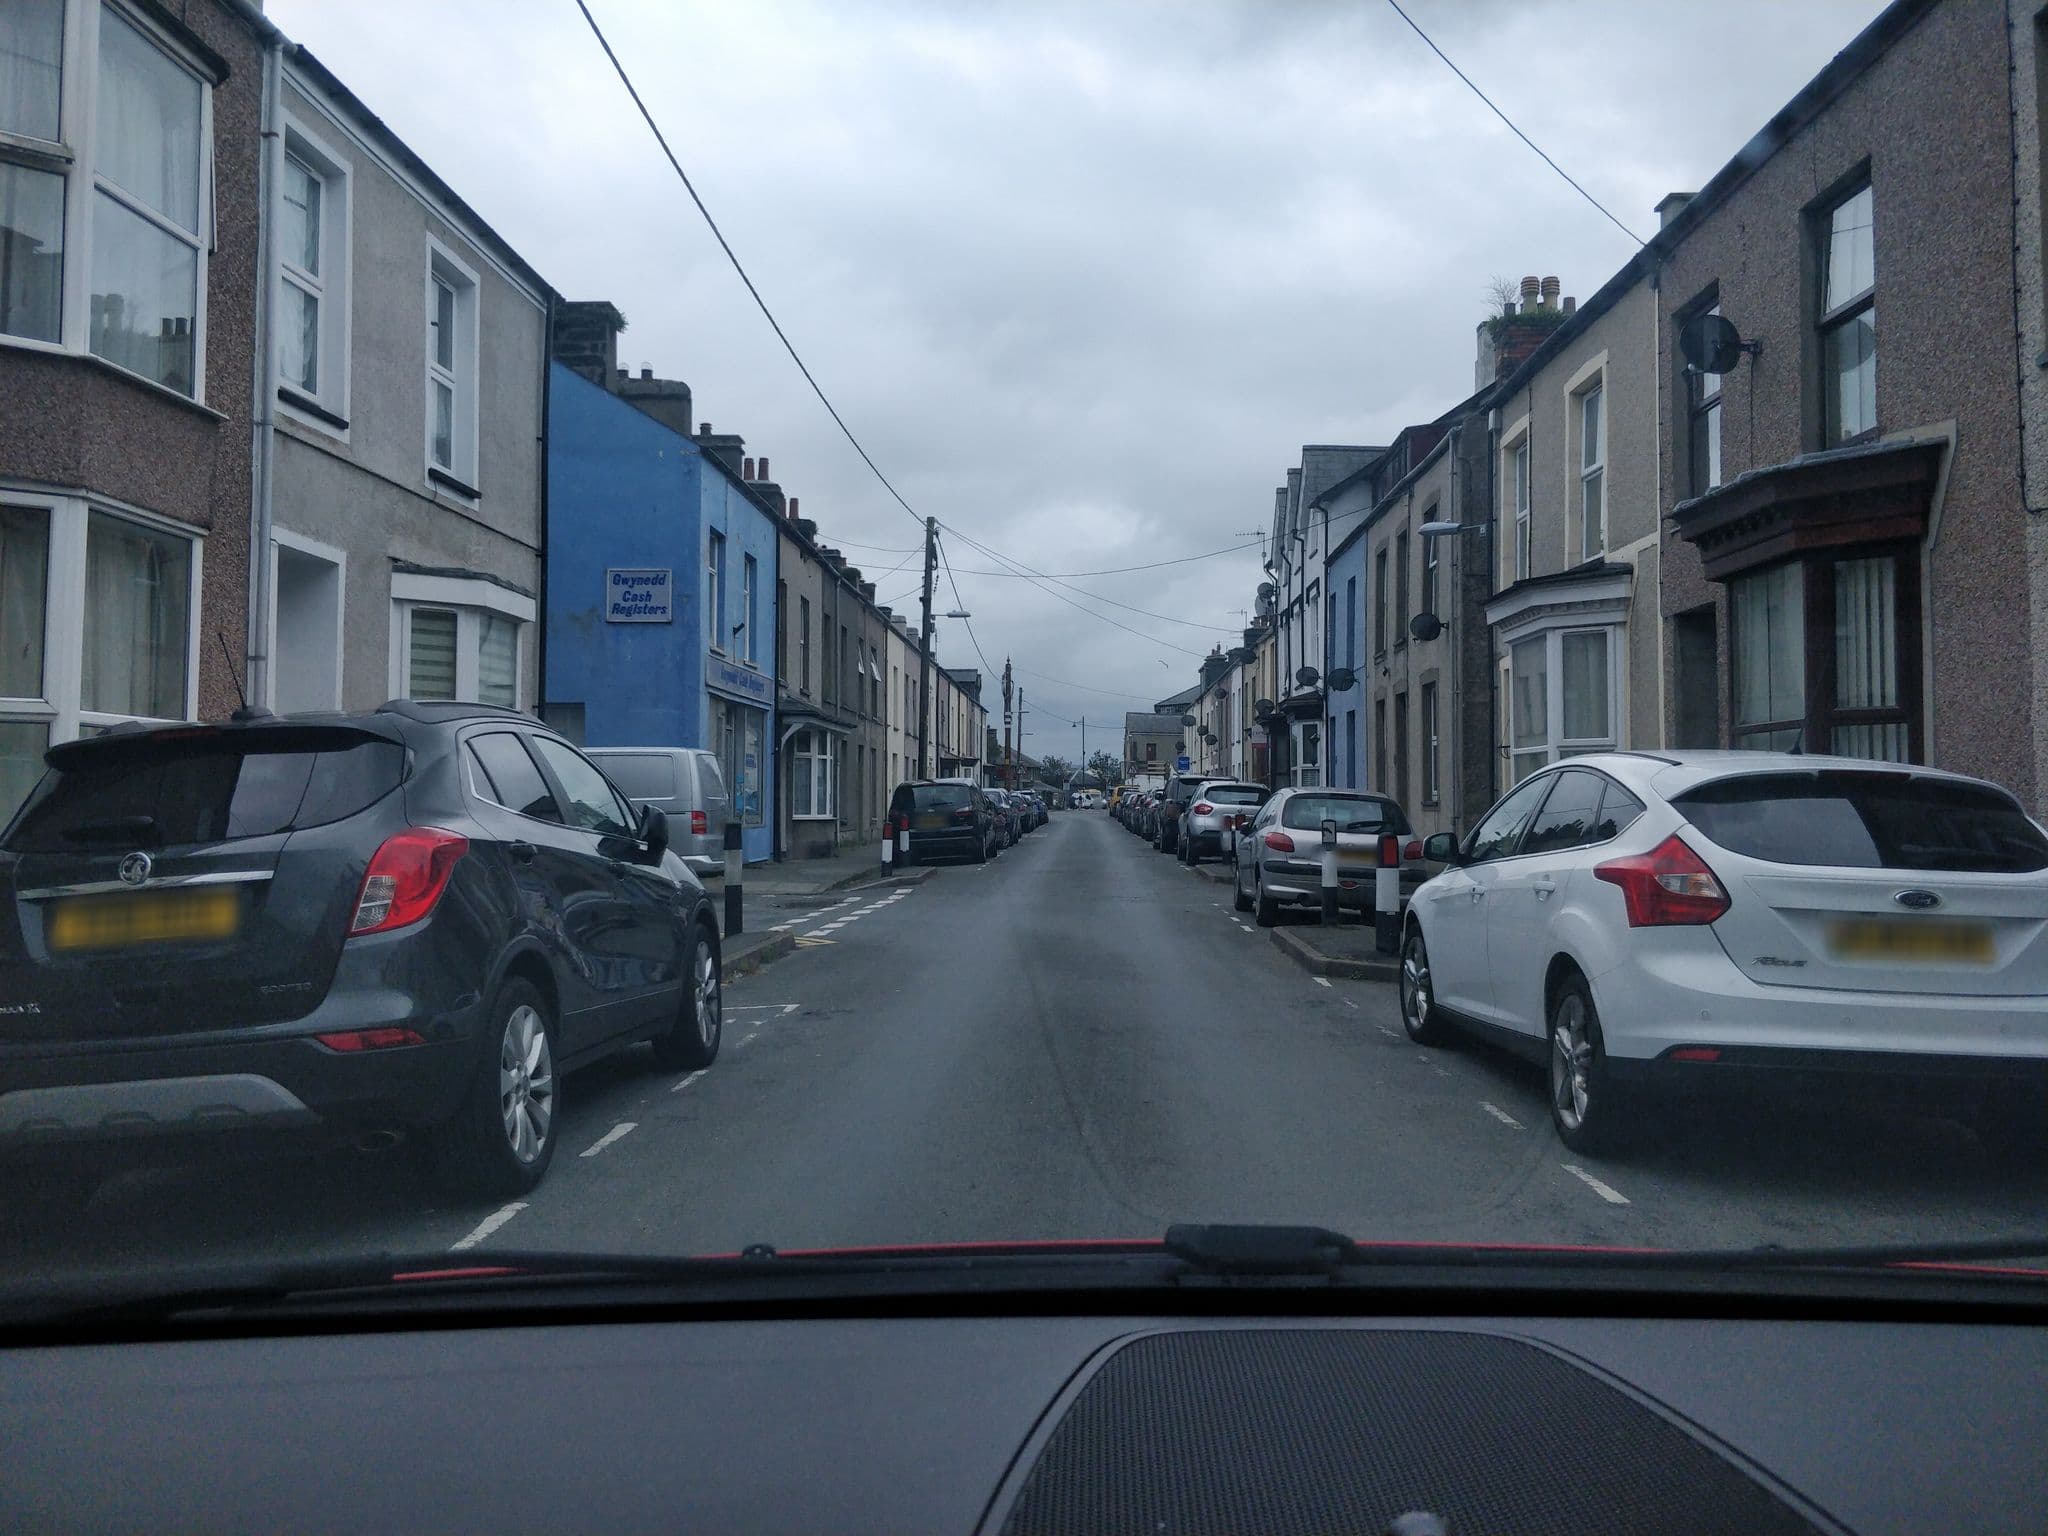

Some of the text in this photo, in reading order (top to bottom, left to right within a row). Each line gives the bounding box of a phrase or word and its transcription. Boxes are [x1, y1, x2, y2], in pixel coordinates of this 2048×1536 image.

[612, 573, 667, 588] Gwynedd
[622, 590, 653, 602] Cash
[611, 602, 668, 617] Registers
